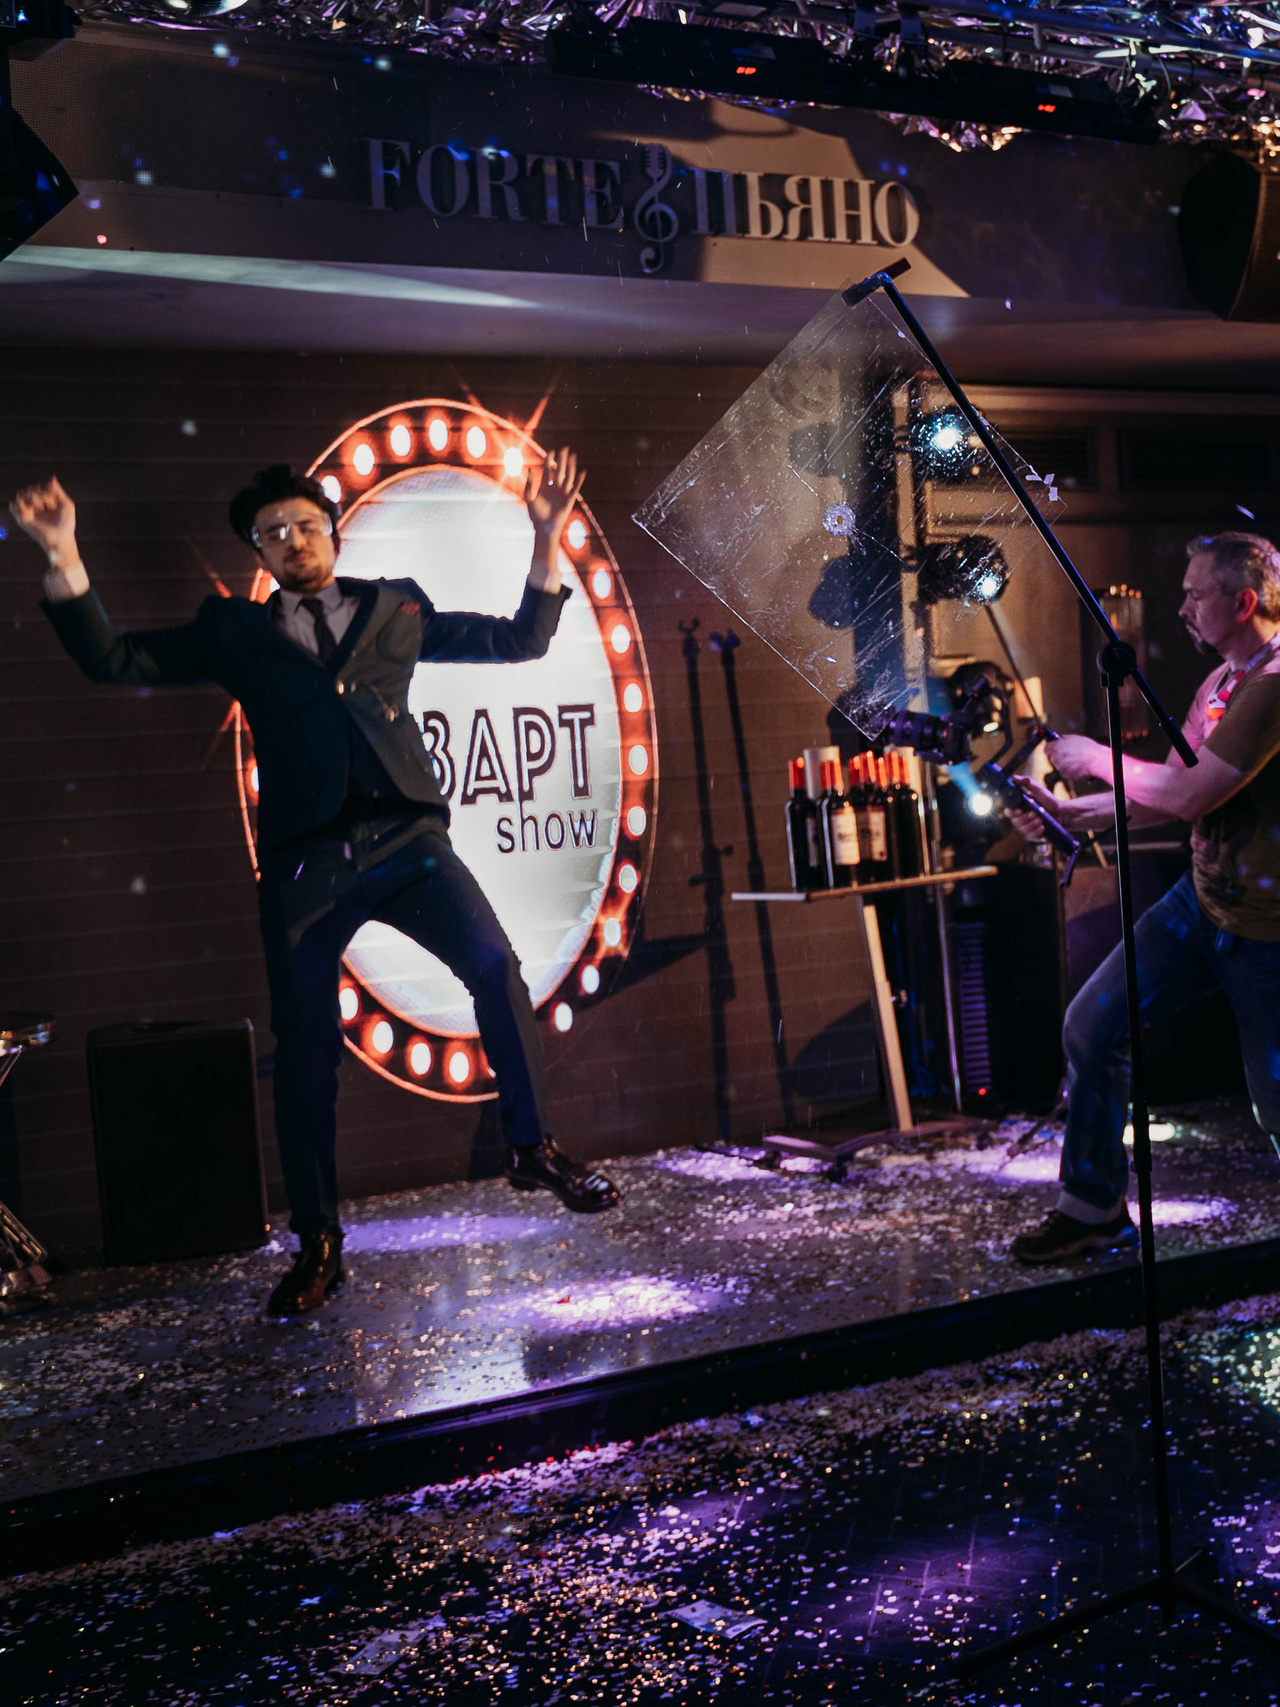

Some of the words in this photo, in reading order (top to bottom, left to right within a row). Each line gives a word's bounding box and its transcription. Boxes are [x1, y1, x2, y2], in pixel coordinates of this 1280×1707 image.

[363, 137, 626, 231] FORTE
[693, 167, 920, 248] ПЬЯНО
[496, 800, 598, 854] show
